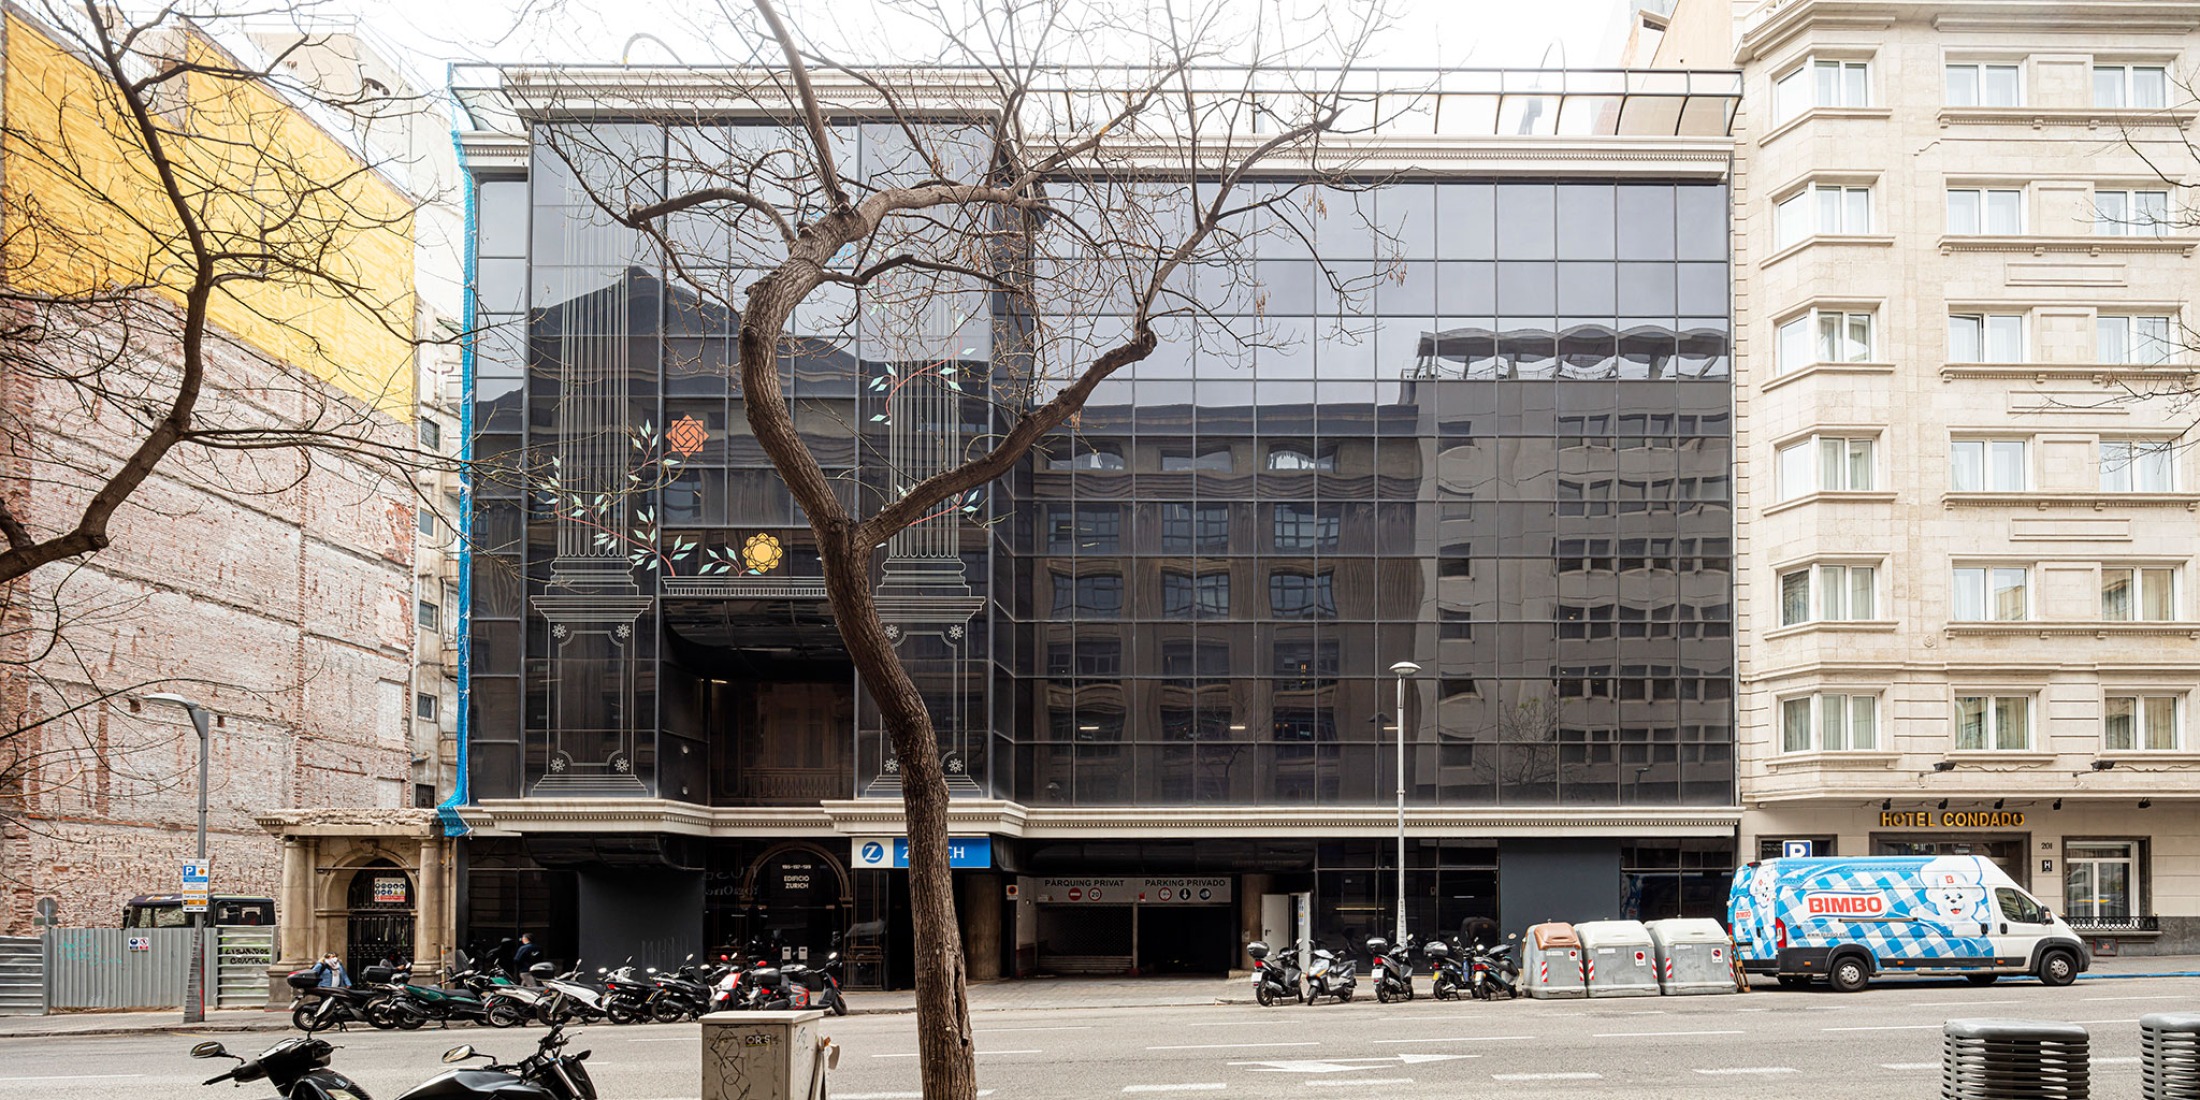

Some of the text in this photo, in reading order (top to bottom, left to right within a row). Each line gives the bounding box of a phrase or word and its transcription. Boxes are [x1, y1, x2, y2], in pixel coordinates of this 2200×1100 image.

[1880, 811, 2025, 826] HOTEL CONDADO
[2041, 842, 2053, 850] 201
[864, 845, 881, 861] Z
[1789, 844, 1806, 858] P
[2044, 861, 2051, 869] H
[1094, 879, 1125, 887] PRIVAT
[1144, 879, 1226, 887] PARKING PRIVADO
[1808, 897, 1882, 913] BIMBO
[230, 957, 271, 965] CONTROL
